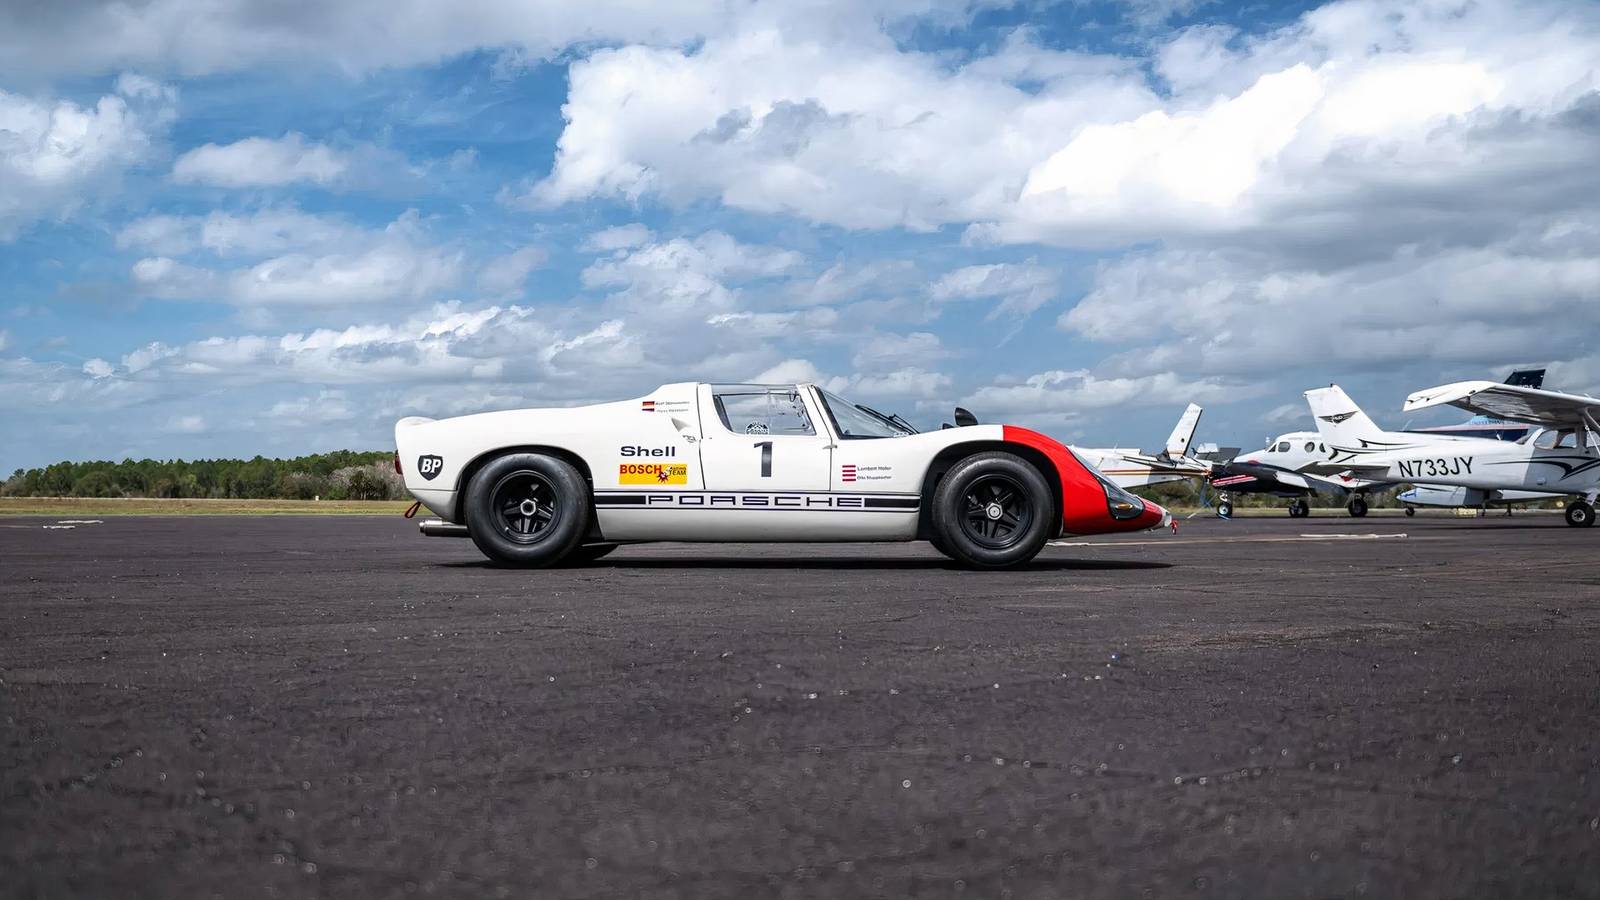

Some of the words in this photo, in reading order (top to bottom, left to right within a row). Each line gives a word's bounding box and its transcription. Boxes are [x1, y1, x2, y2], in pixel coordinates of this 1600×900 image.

[620, 446, 675, 457] Shell
[421, 458, 442, 473] BP
[753, 441, 773, 478] 1
[619, 464, 662, 474] BOSCH
[1398, 456, 1473, 478] N733JY
[648, 495, 862, 507] PORSCHE
